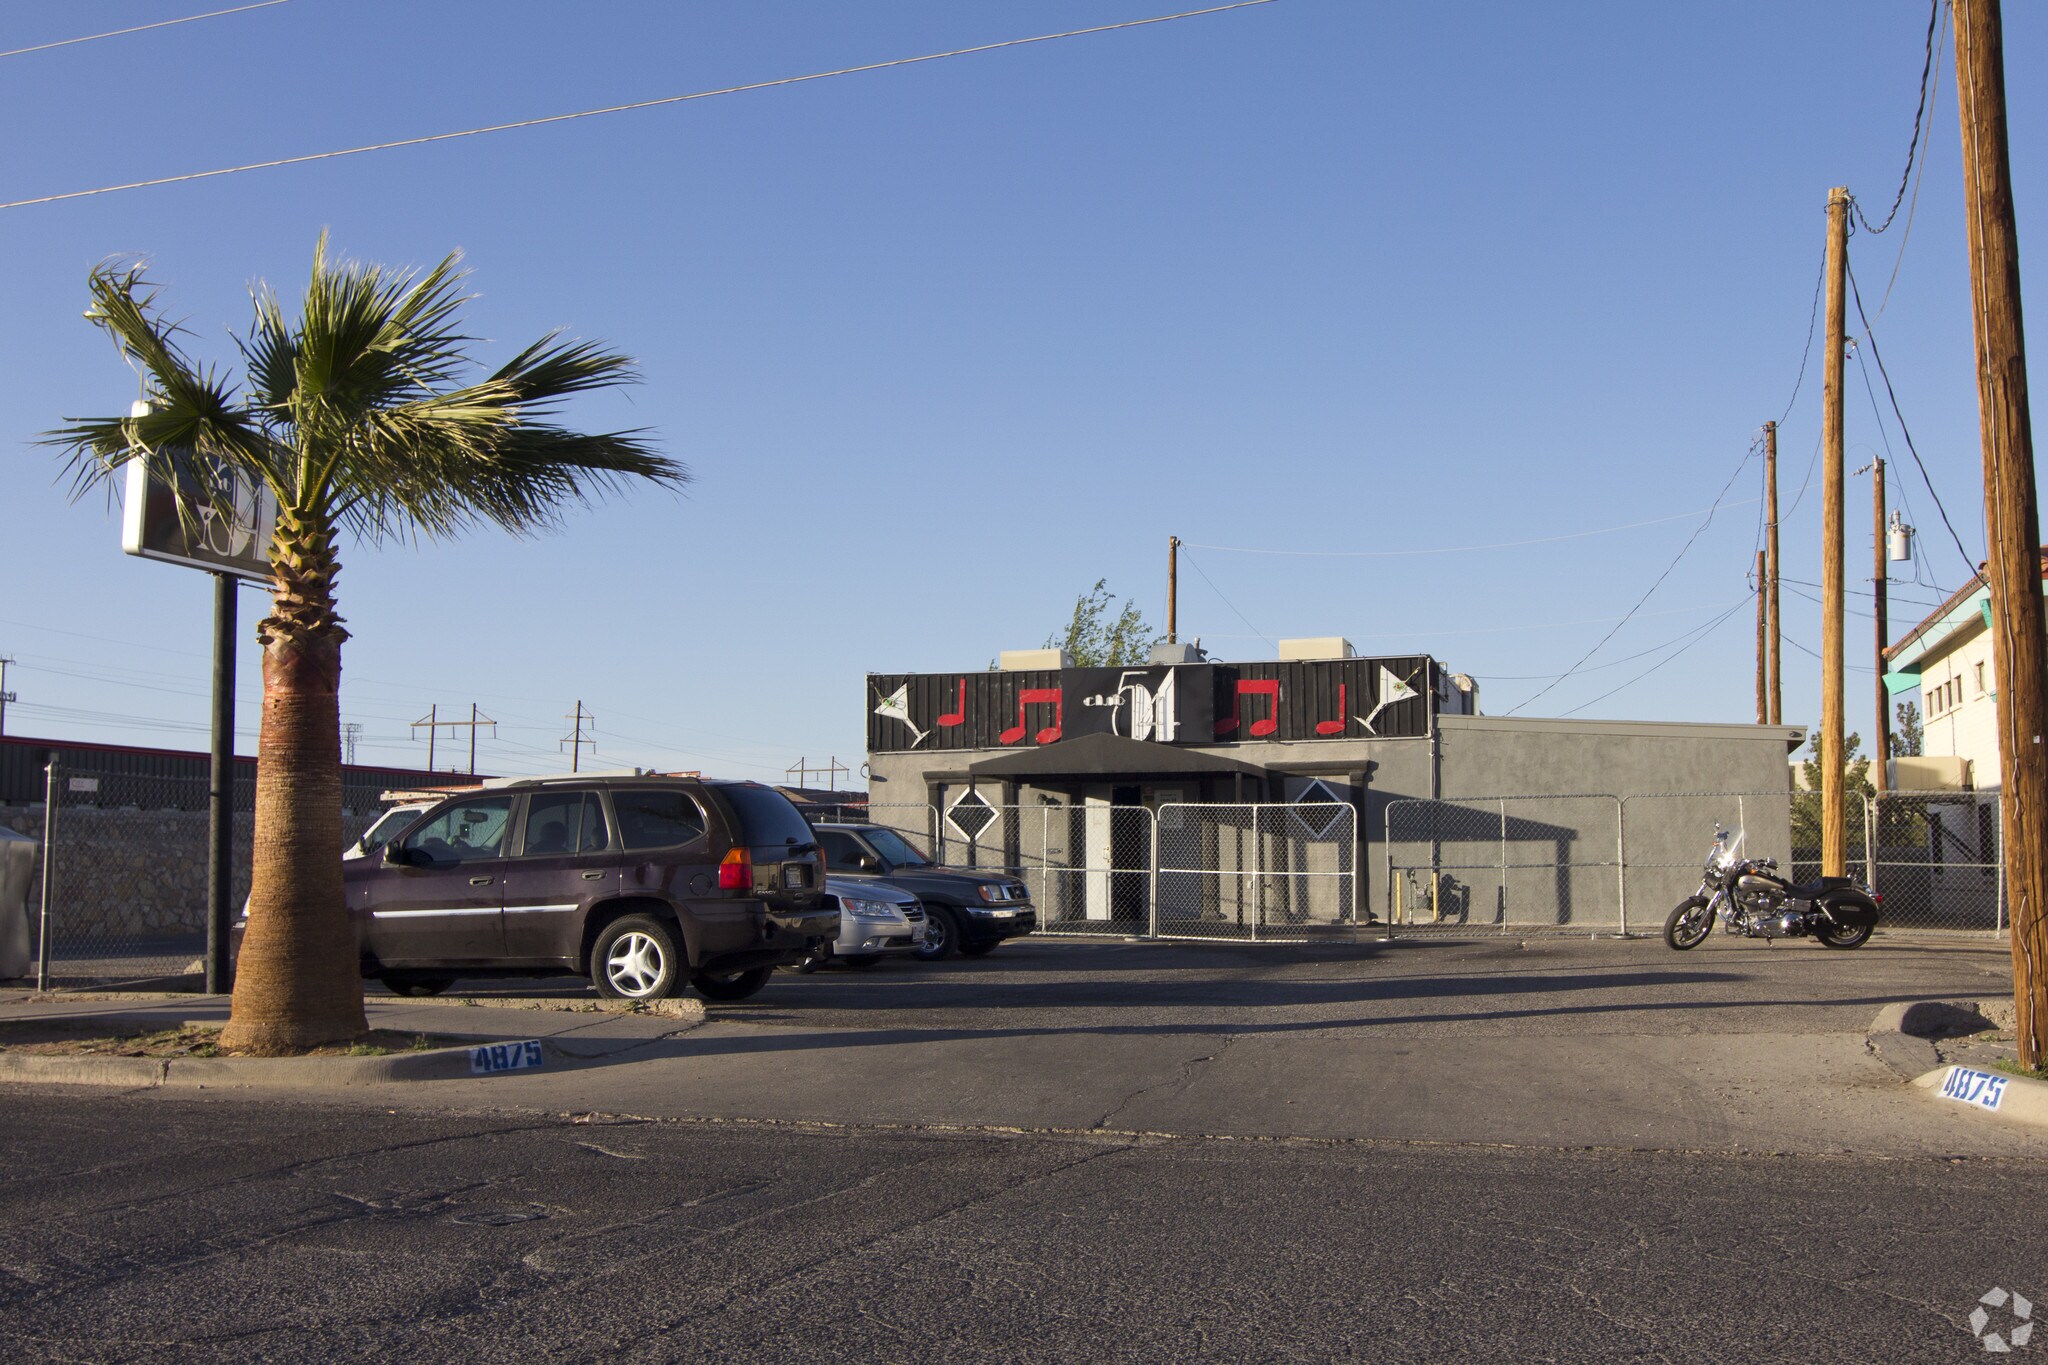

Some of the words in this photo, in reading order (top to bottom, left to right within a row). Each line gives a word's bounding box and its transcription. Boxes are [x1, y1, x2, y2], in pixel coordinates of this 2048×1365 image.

[1112, 666, 1181, 742] 54
[475, 1040, 542, 1070] 4875
[1943, 1068, 2008, 1107] 4875
